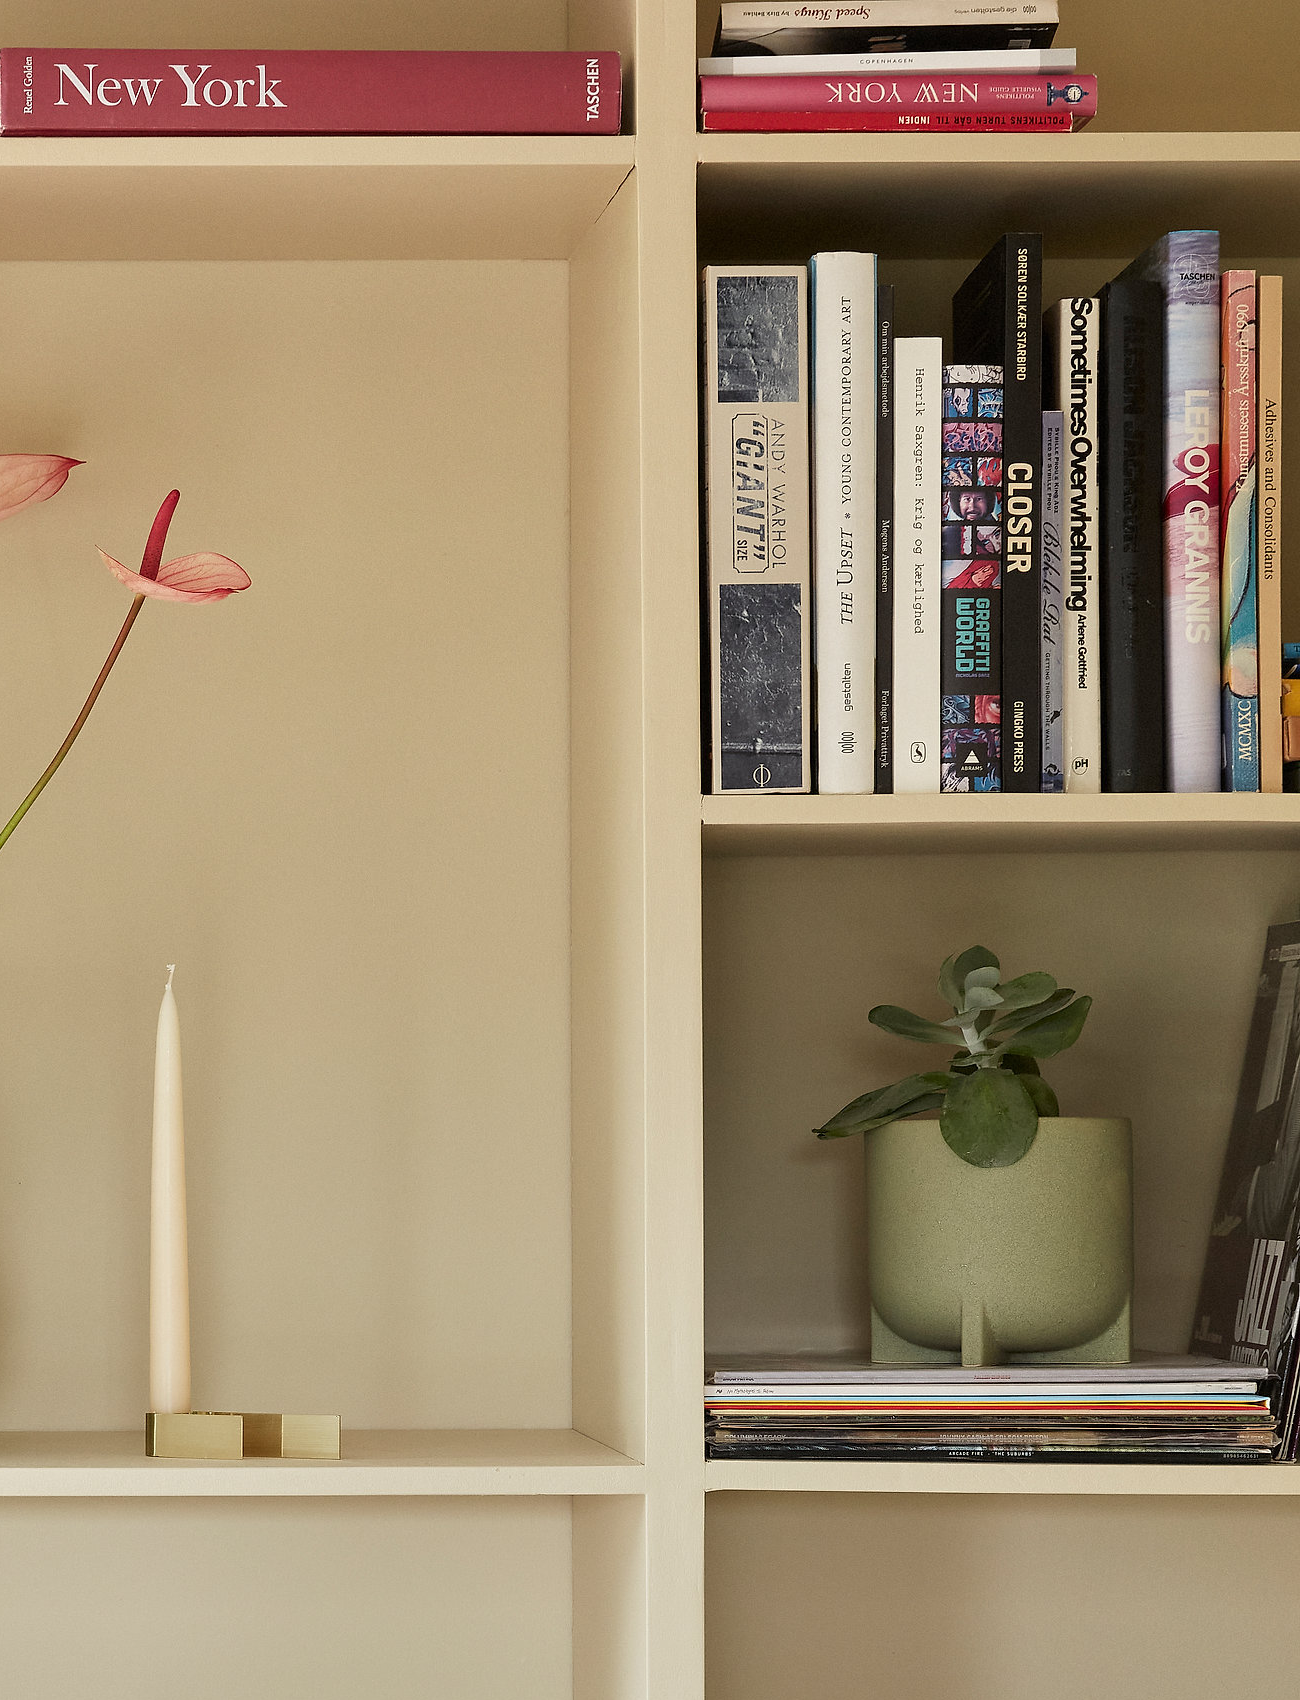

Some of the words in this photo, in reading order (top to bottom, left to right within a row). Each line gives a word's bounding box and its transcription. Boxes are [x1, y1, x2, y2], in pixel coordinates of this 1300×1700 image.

[794, 6, 833, 21] Kings
[835, 5, 871, 20] Speed
[23, 56, 34, 87] Golden
[53, 63, 164, 107] New
[168, 64, 288, 108] York
[585, 58, 600, 122] TASCHEN
[22, 88, 34, 114] Reuel
[825, 82, 903, 103] YORK
[913, 82, 979, 103] NEW
[898, 115, 930, 125] INDIEN
[935, 116, 950, 125] TIL
[953, 116, 972, 127] GÅR
[975, 116, 1006, 125] TUREN
[1010, 116, 1065, 125] POLITIKENS
[1017, 248, 1028, 283] SØREN
[841, 296, 851, 324] ART
[1016, 284, 1028, 329] SOLKÆR
[881, 320, 890, 341] Om
[881, 338, 890, 355] min
[1016, 331, 1027, 381] STARBIRD
[1068, 298, 1092, 435] Sometimes
[841, 332, 852, 447] CONTEMPORARY
[880, 356, 890, 418] arbejdsmetode
[915, 368, 926, 417] Henrik
[770, 418, 786, 474] ANDY
[1183, 389, 1209, 498] LEROY
[1264, 398, 1277, 463] Adhesives
[913, 425, 925, 487] Saxgren:
[841, 453, 852, 505] YOUNG
[1264, 467, 1277, 491] and
[771, 483, 787, 569] WARHOL
[912, 498, 926, 530] Krig
[1006, 462, 1033, 573] CLOSER
[1067, 436, 1092, 611] Overwhelming
[736, 539, 748, 562] SIZE
[880, 519, 890, 552] Mogens
[912, 538, 923, 555] og
[1042, 522, 1060, 581] Blek
[1264, 496, 1277, 580] Consolidants
[881, 553, 890, 593] Andersen
[1042, 579, 1060, 596] le
[1184, 500, 1210, 643] GRANNIS
[840, 591, 853, 625] THE
[912, 563, 925, 634] kærlighed
[955, 597, 975, 672] WORLD
[975, 597, 991, 672] GRAFFITI
[1042, 599, 1058, 645] Rat
[1077, 613, 1087, 646] Arlene
[1077, 646, 1088, 689] Gottfried
[879, 690, 890, 724] Forlaget
[1013, 701, 1024, 739] GINGKO
[879, 725, 890, 768] Privattryk
[1238, 700, 1252, 760] MCMXC
[1013, 741, 1024, 773] PRESS
